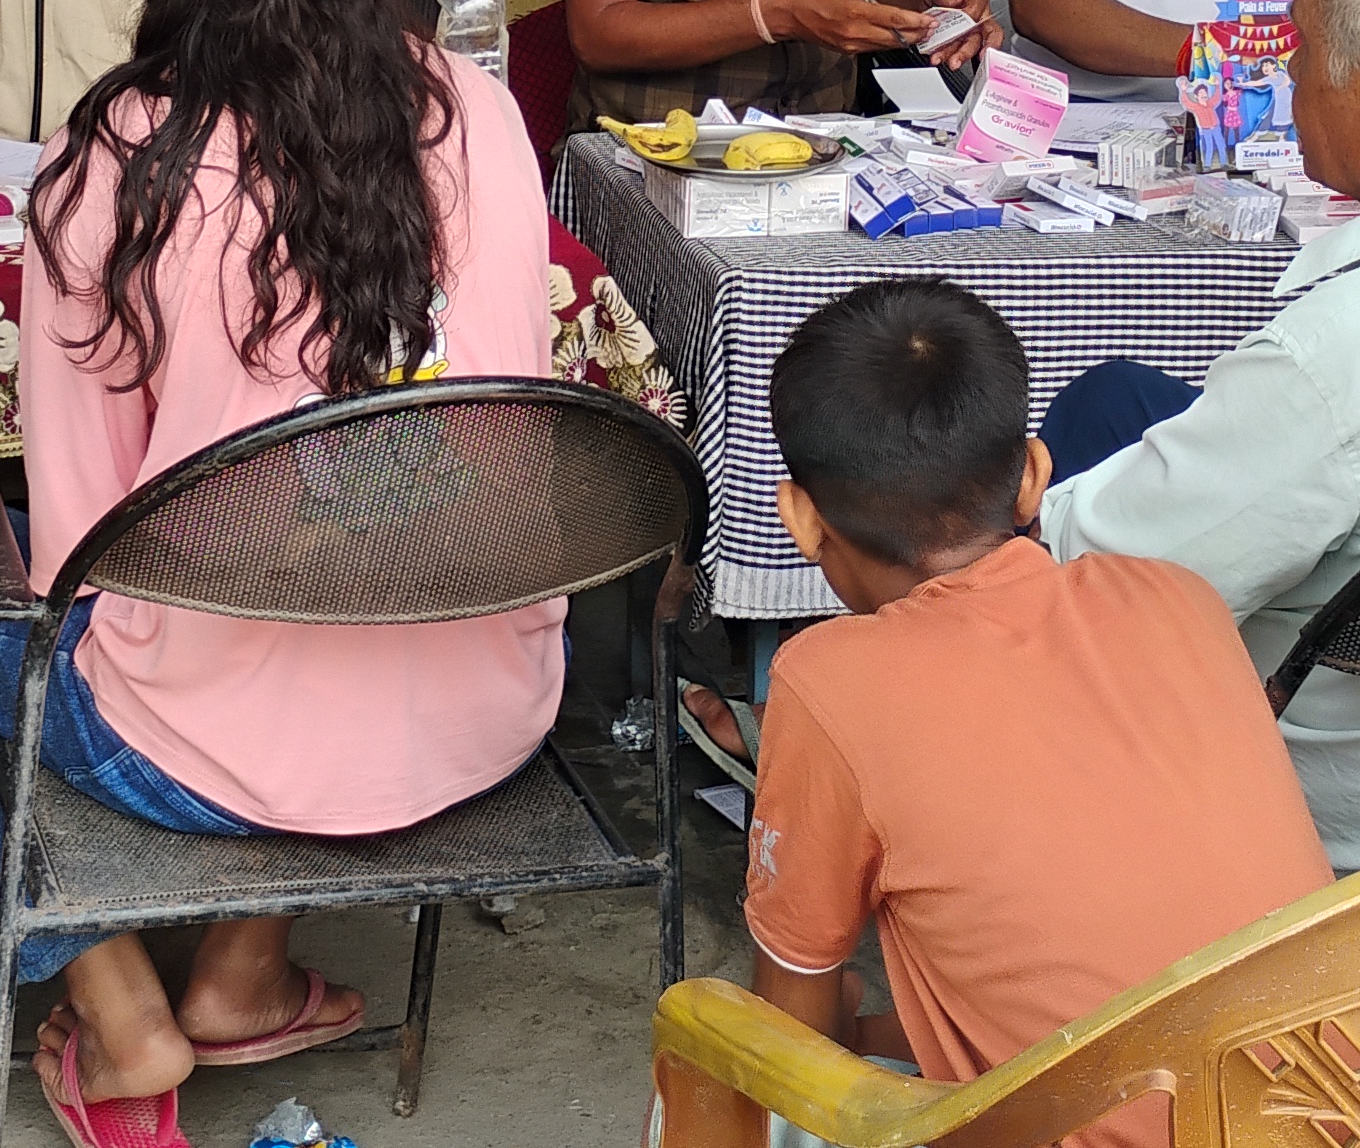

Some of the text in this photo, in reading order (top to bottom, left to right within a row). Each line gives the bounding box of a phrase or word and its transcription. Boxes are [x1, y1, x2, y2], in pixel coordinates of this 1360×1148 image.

[1238, 1, 1257, 13] Pain
[1265, 1, 1288, 13] Fever
[991, 114, 1033, 135] Gravion
[1242, 148, 1291, 158] Zerodol-P
